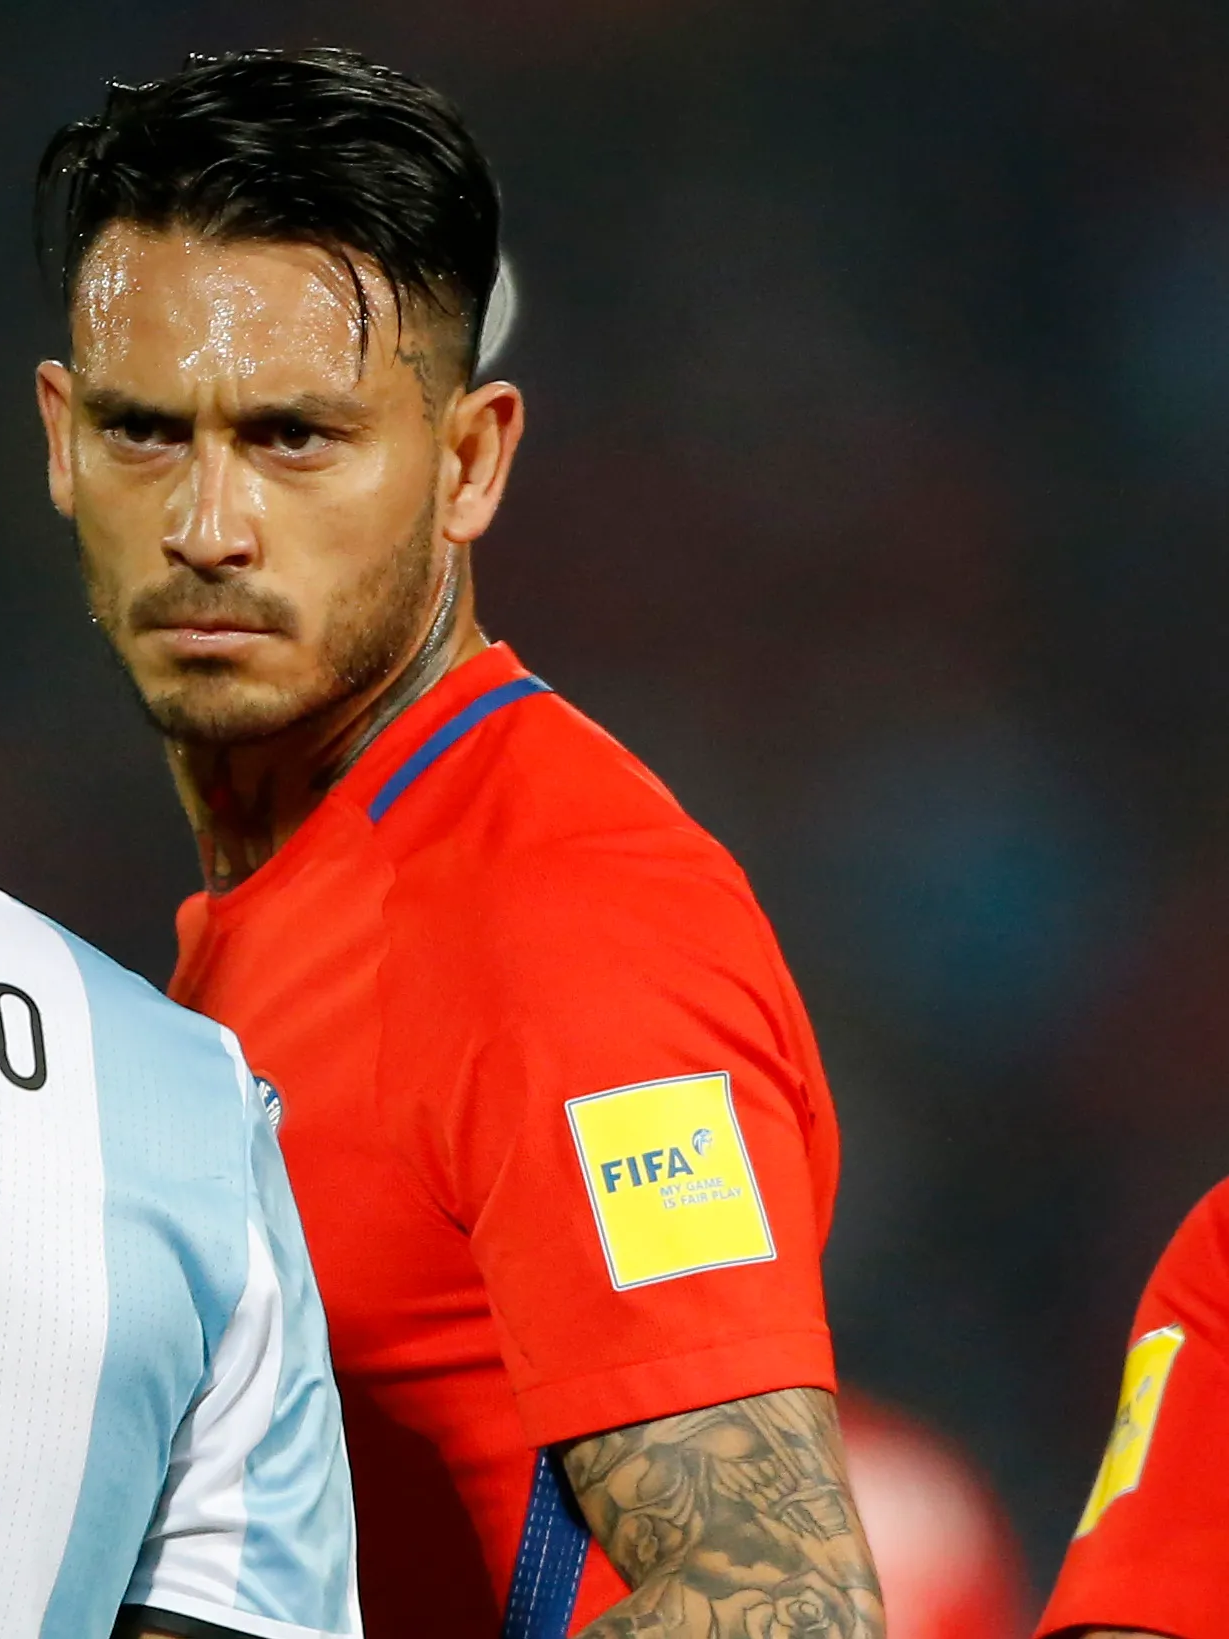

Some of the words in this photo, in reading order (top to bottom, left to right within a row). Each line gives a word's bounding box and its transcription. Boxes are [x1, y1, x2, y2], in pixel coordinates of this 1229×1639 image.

[601, 1147, 693, 1193] FIFA
[660, 1184, 681, 1197] MY
[686, 1177, 723, 1191] GAME
[663, 1198, 676, 1209] IS
[681, 1192, 708, 1205] FAIR
[712, 1187, 742, 1200] PLAY
